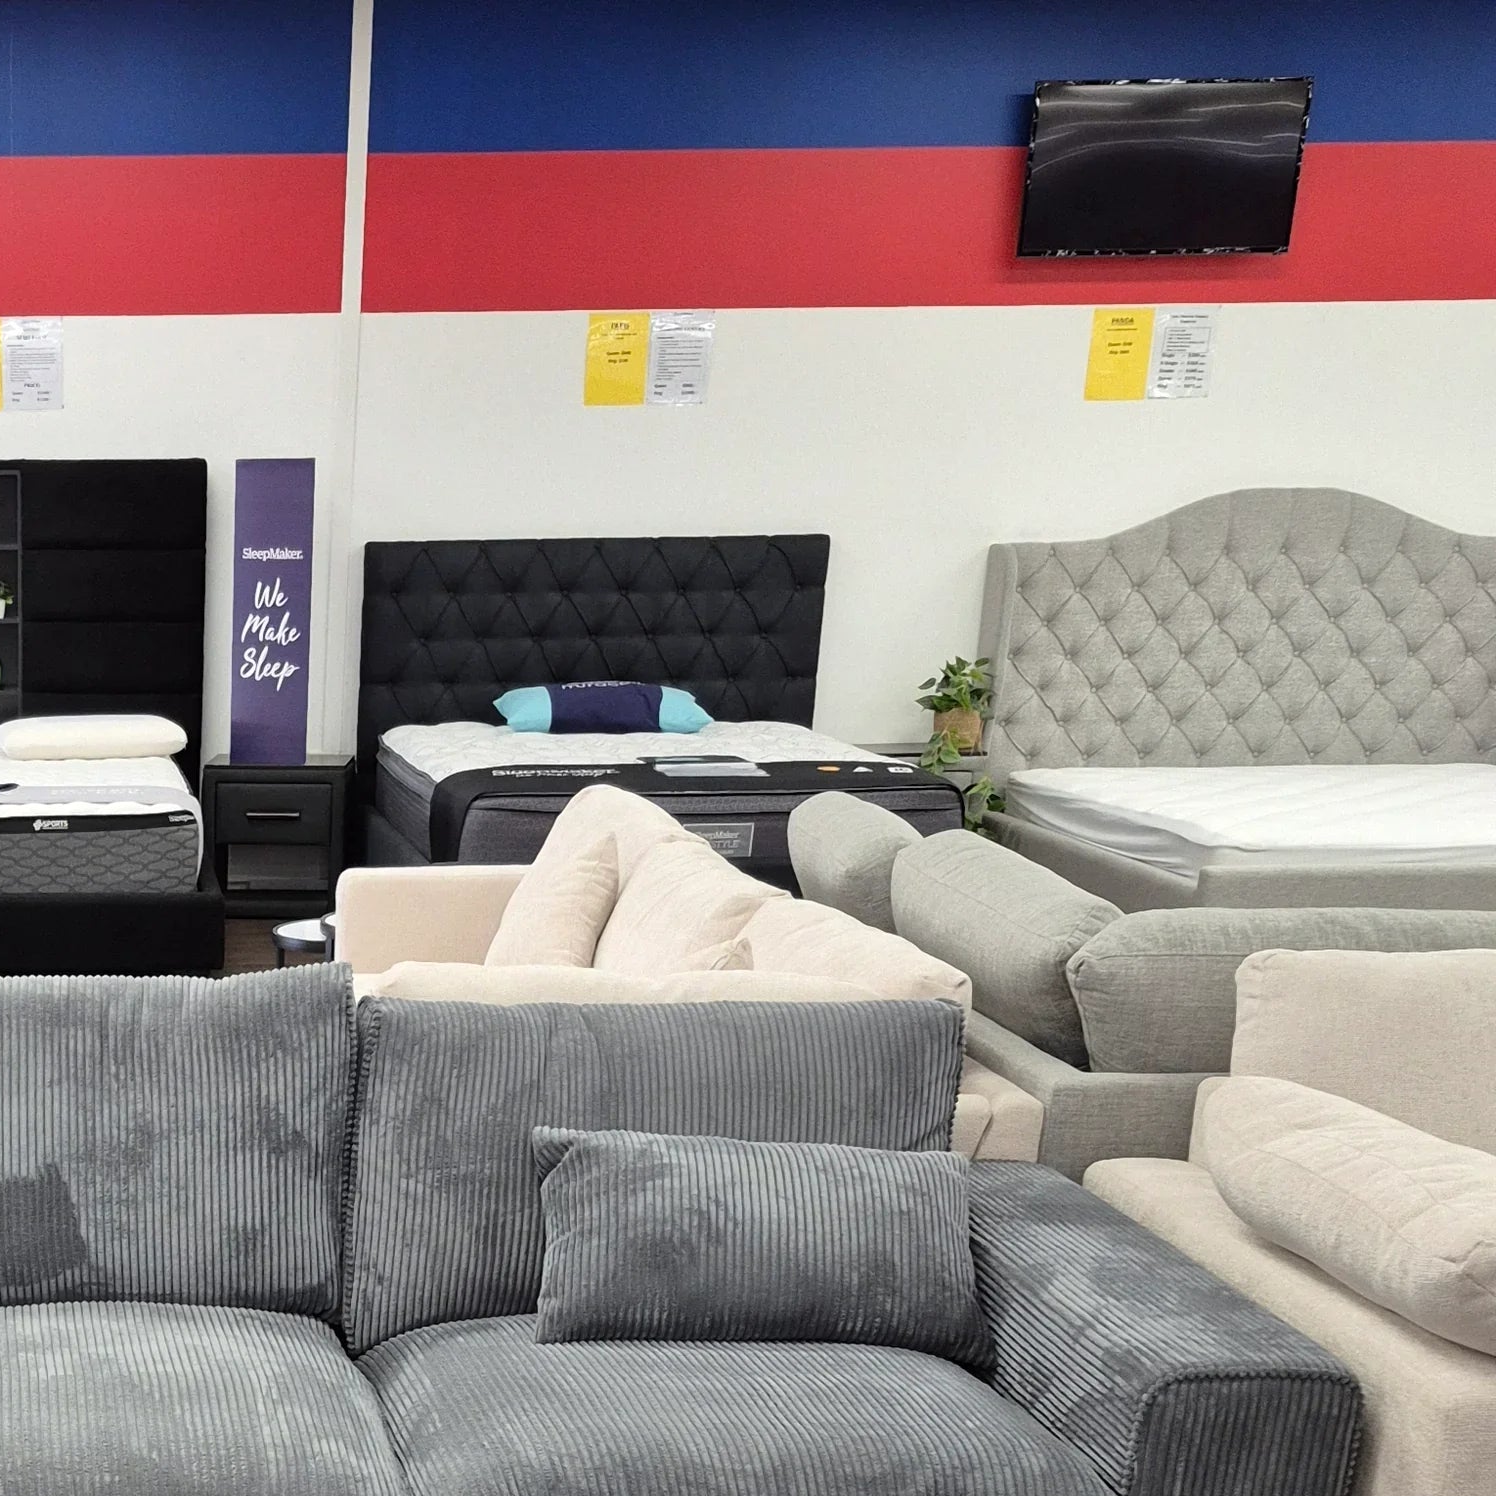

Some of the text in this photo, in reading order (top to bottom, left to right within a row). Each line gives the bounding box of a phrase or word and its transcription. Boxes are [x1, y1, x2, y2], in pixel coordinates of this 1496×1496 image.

[254, 577, 289, 609] We
[240, 611, 301, 646] Make
[240, 645, 300, 692] Sleep
